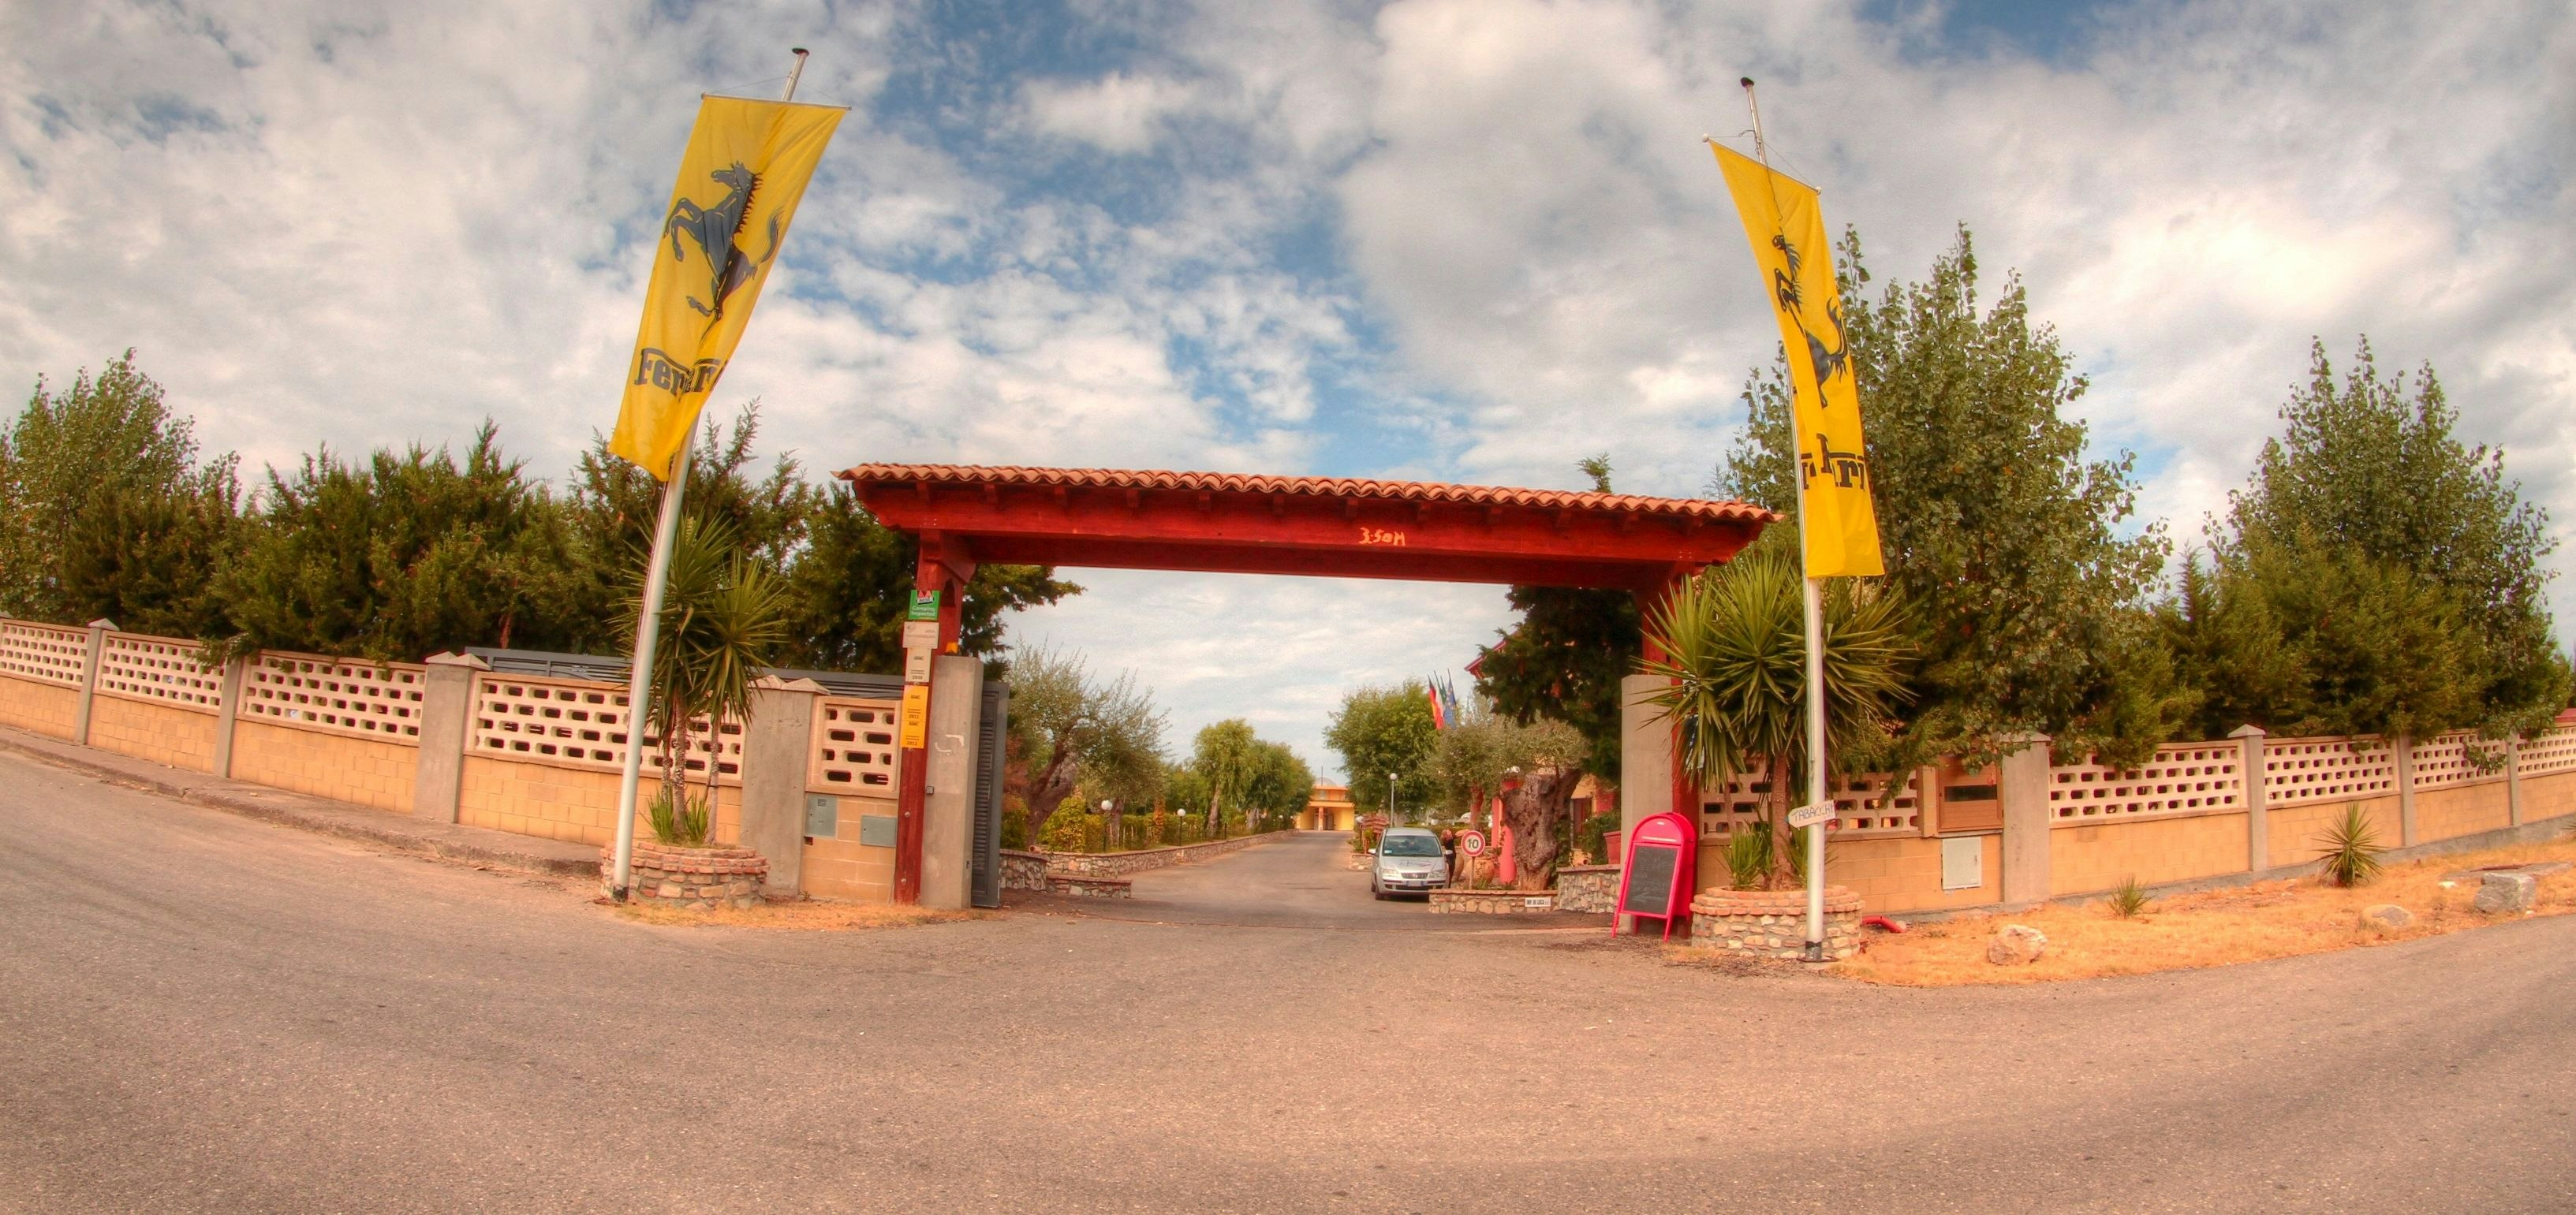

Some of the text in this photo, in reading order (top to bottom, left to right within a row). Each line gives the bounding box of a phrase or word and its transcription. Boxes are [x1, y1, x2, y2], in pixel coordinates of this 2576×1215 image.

[634, 347, 728, 399] Ferr
[1791, 803, 1832, 822] TABACCHI
[1467, 839, 1479, 848] 10
